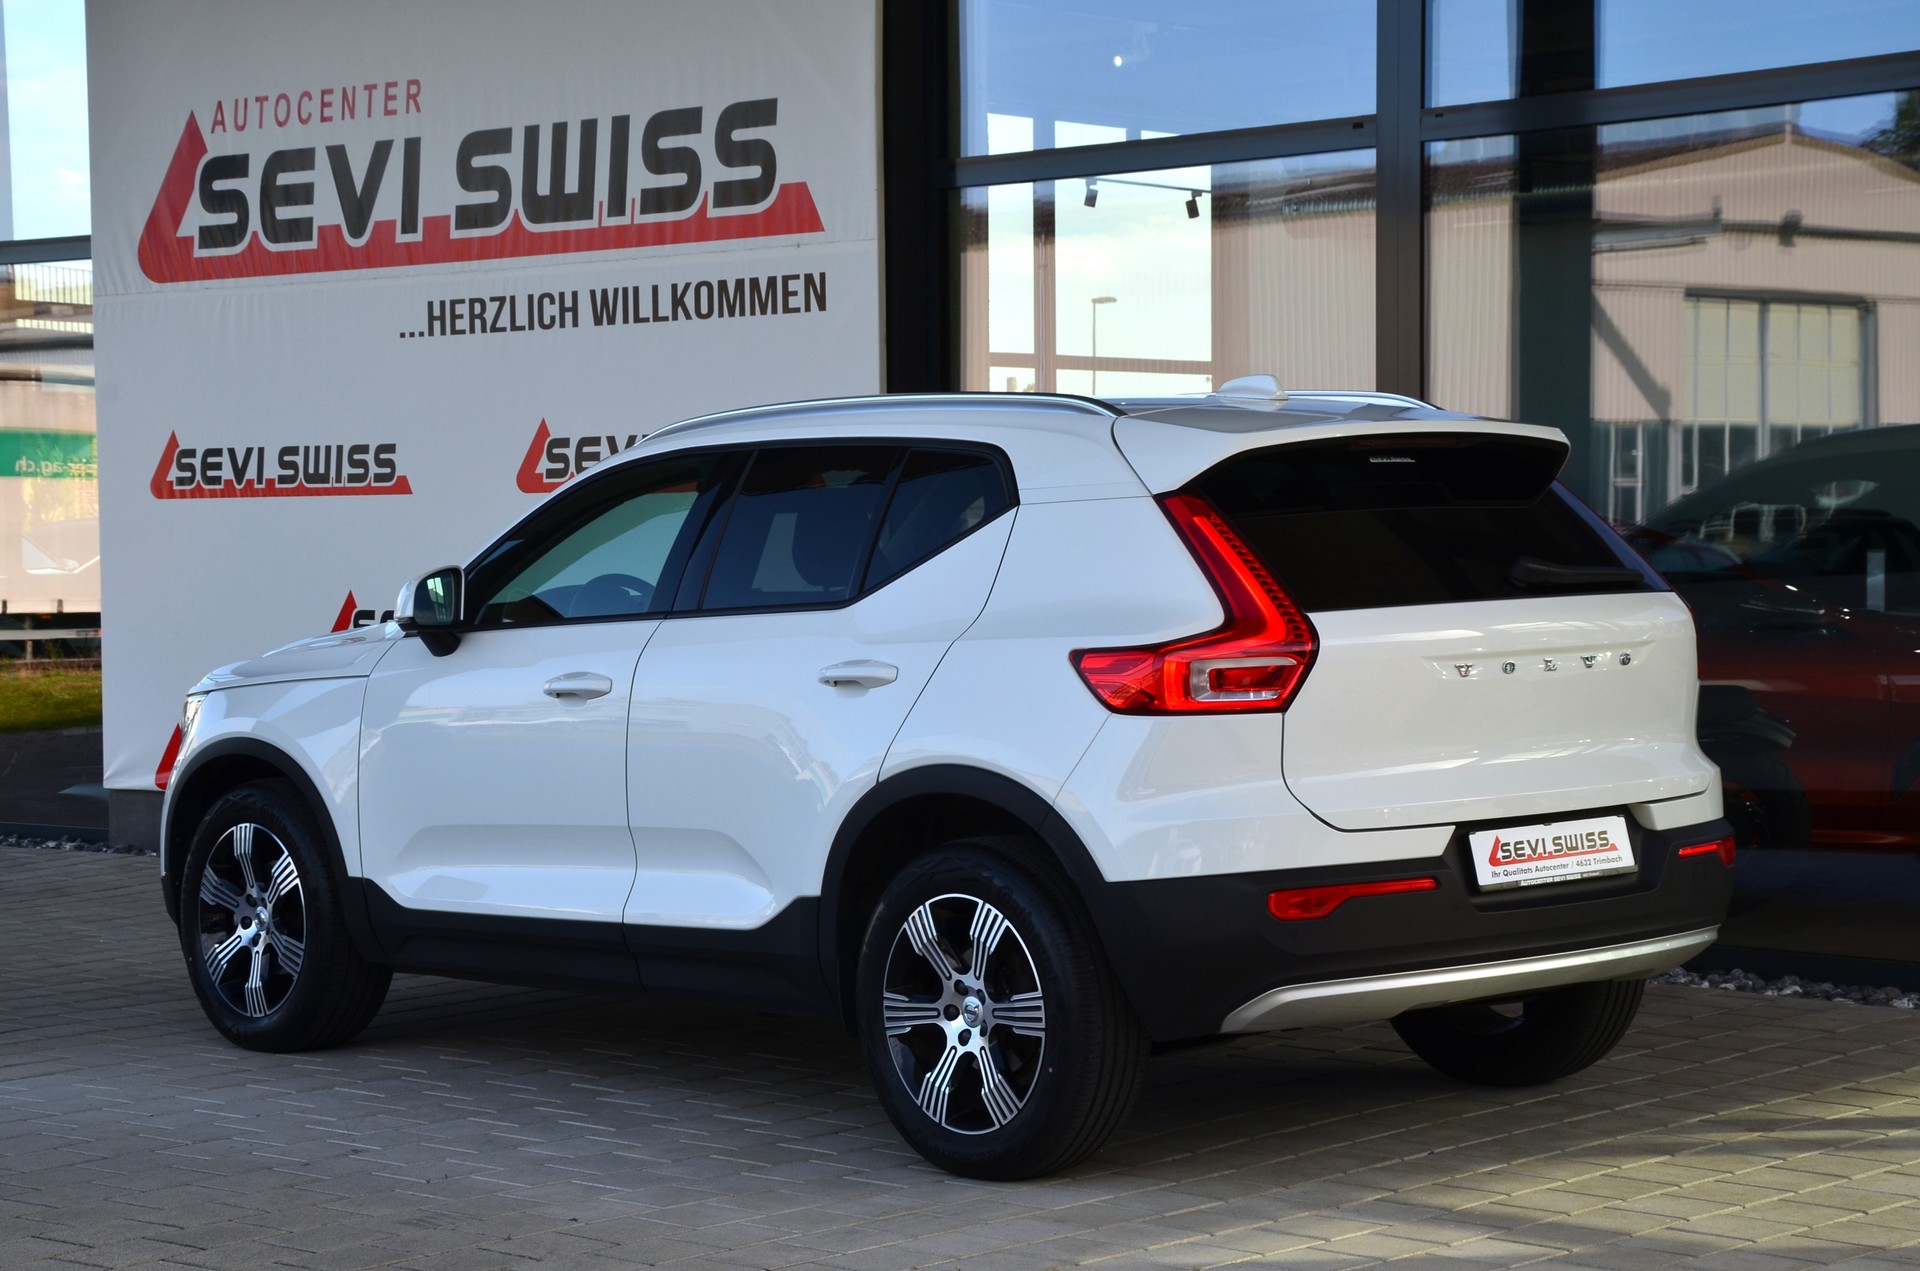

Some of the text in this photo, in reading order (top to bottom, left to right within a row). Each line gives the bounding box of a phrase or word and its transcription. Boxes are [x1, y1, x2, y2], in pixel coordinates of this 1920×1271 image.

[211, 79, 422, 134] AUTOCENTER
[198, 97, 778, 250] SEVI SWISS
[589, 271, 827, 327] WILLKOMMEN
[175, 443, 397, 487] SEVI SWISS
[1455, 652, 1632, 677] VOLVO
[1491, 871, 1501, 879] Ihr
[1535, 862, 1569, 873] Autocenter
[1576, 858, 1592, 868] 4632
[1594, 855, 1623, 865] Trimbach
[1500, 830, 1610, 860] SEVI SWISS
